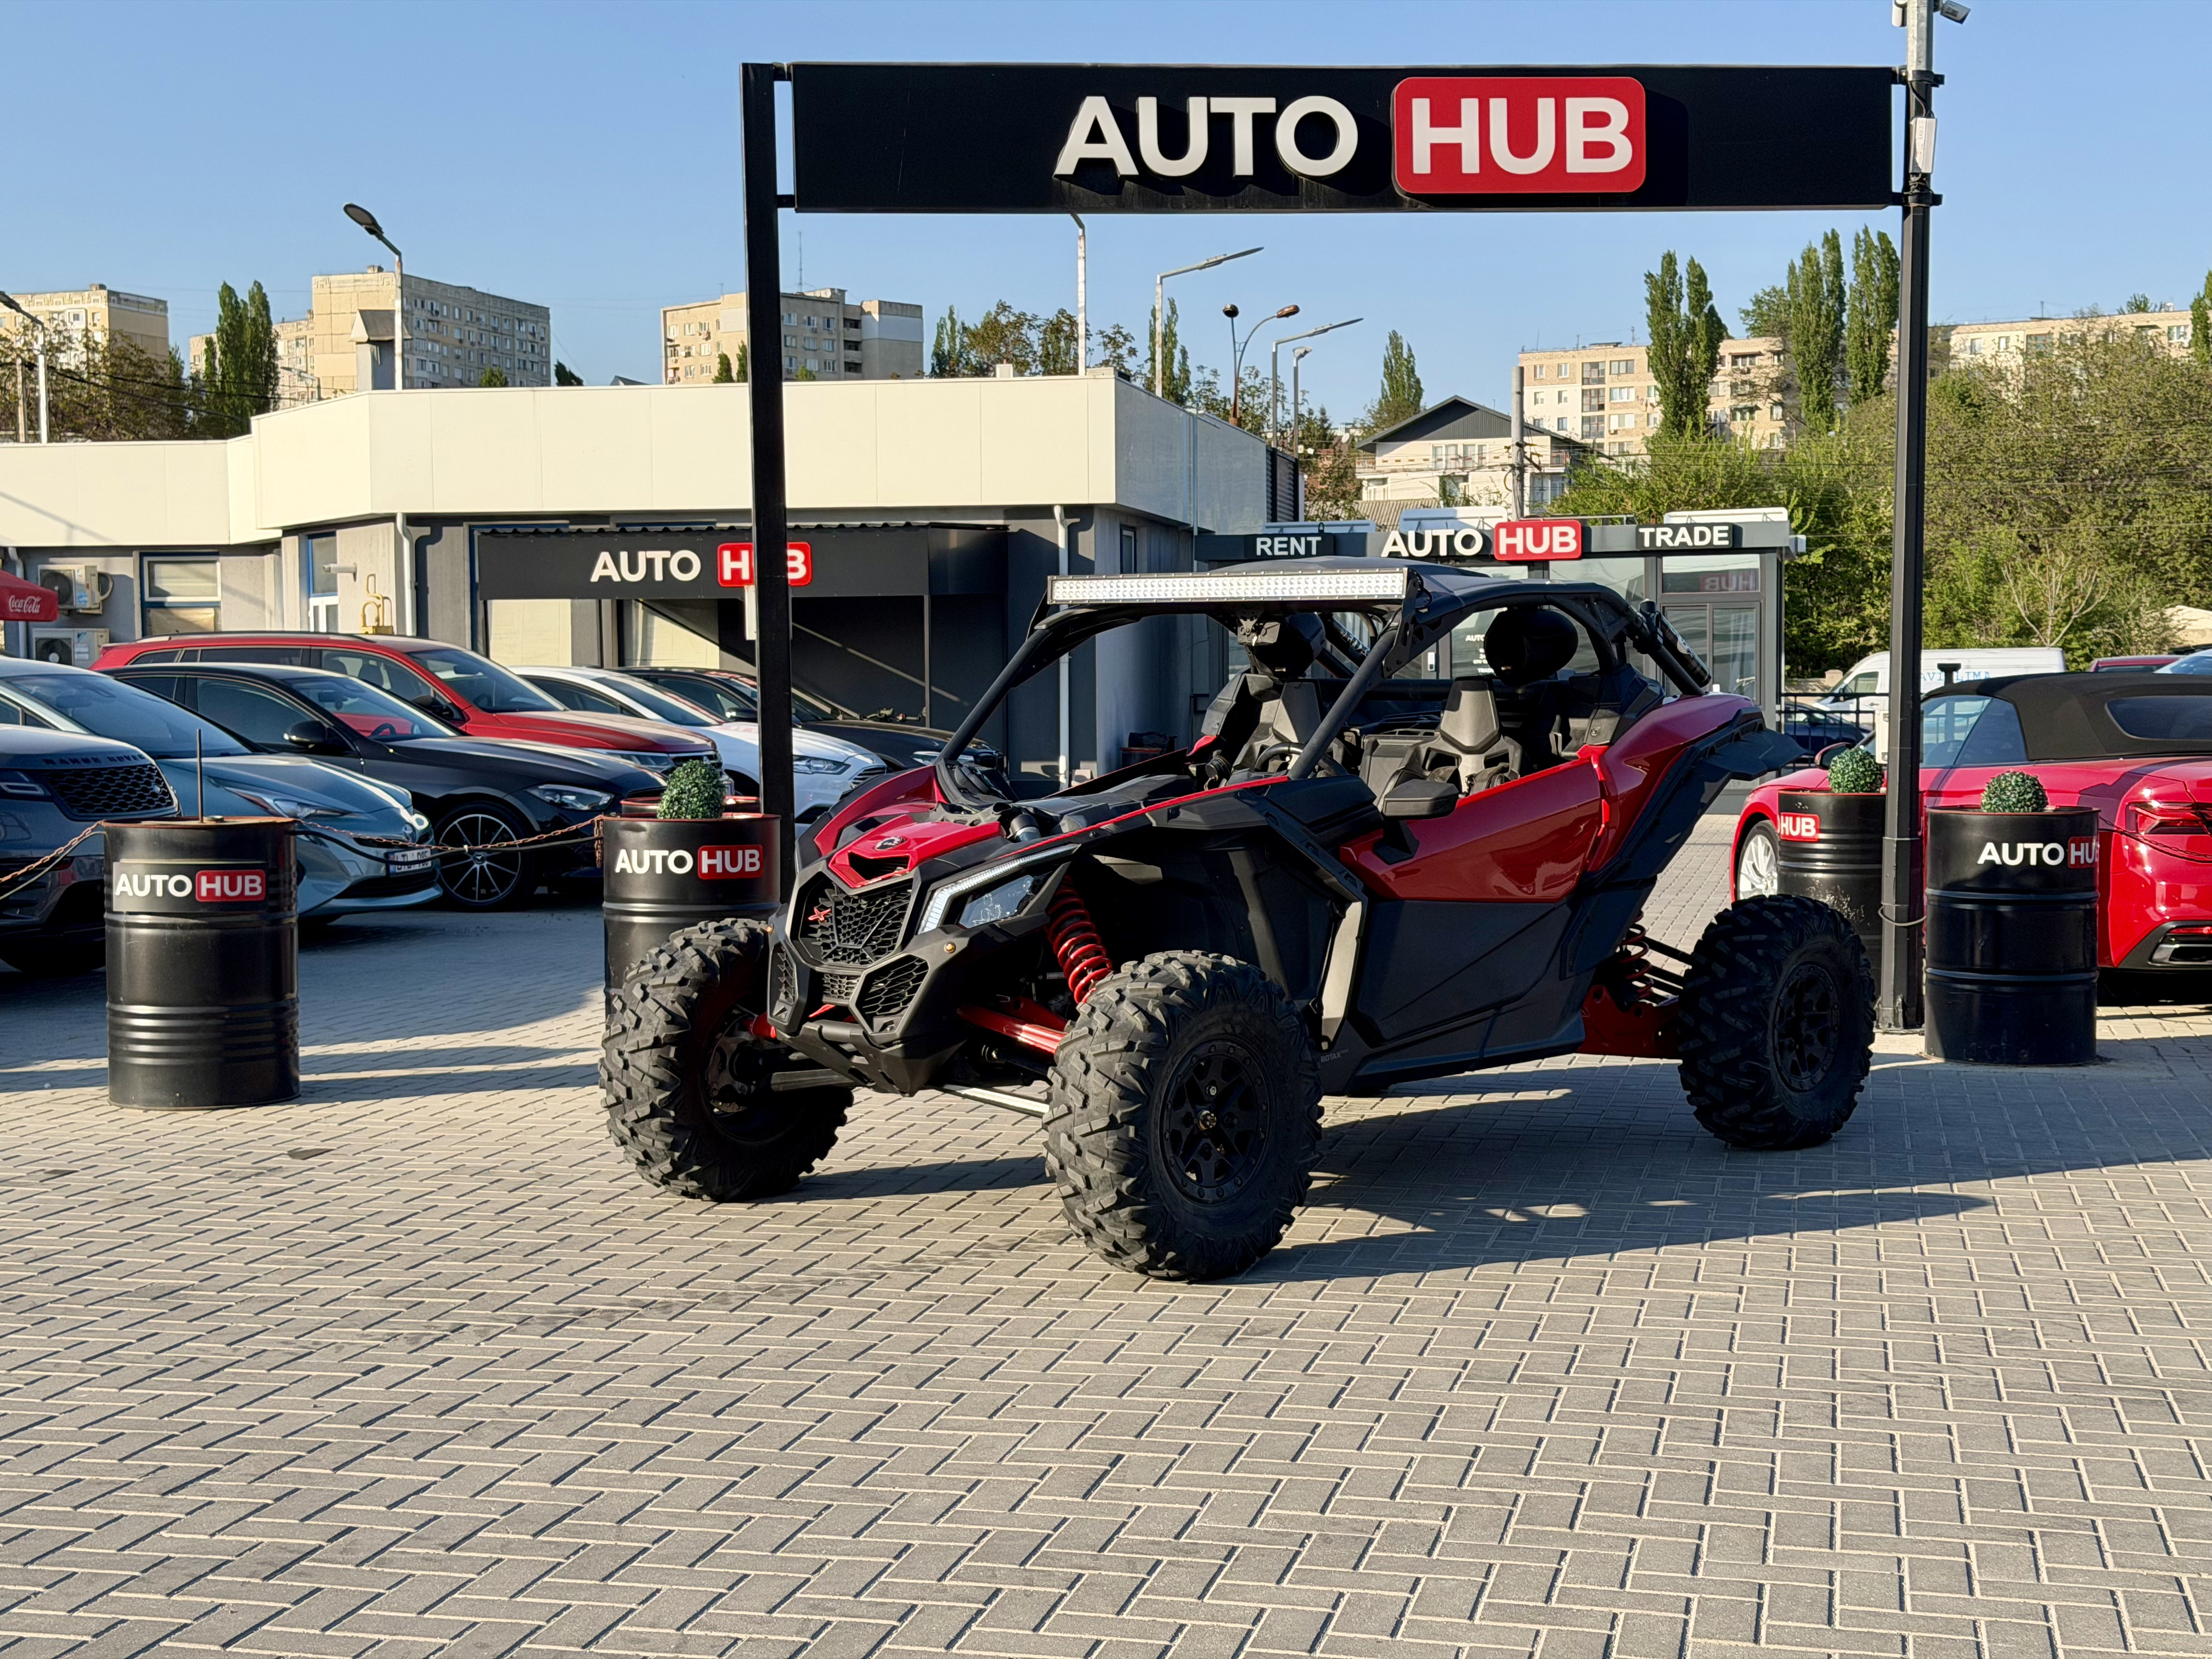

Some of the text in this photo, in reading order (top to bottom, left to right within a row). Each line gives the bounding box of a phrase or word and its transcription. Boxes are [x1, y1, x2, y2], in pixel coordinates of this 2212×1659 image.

[1053, 95, 1633, 176] AUTO HUB
[1256, 537, 1322, 556] RENT
[1381, 526, 1577, 557] AUTO HUB
[1639, 526, 1729, 548] TRADE
[590, 549, 807, 582] AUTO HB
[1780, 815, 1816, 837] HUB
[615, 849, 760, 874] AUTO HUB
[1977, 842, 2064, 866] AUTO
[115, 873, 262, 897] AUTO HUB
